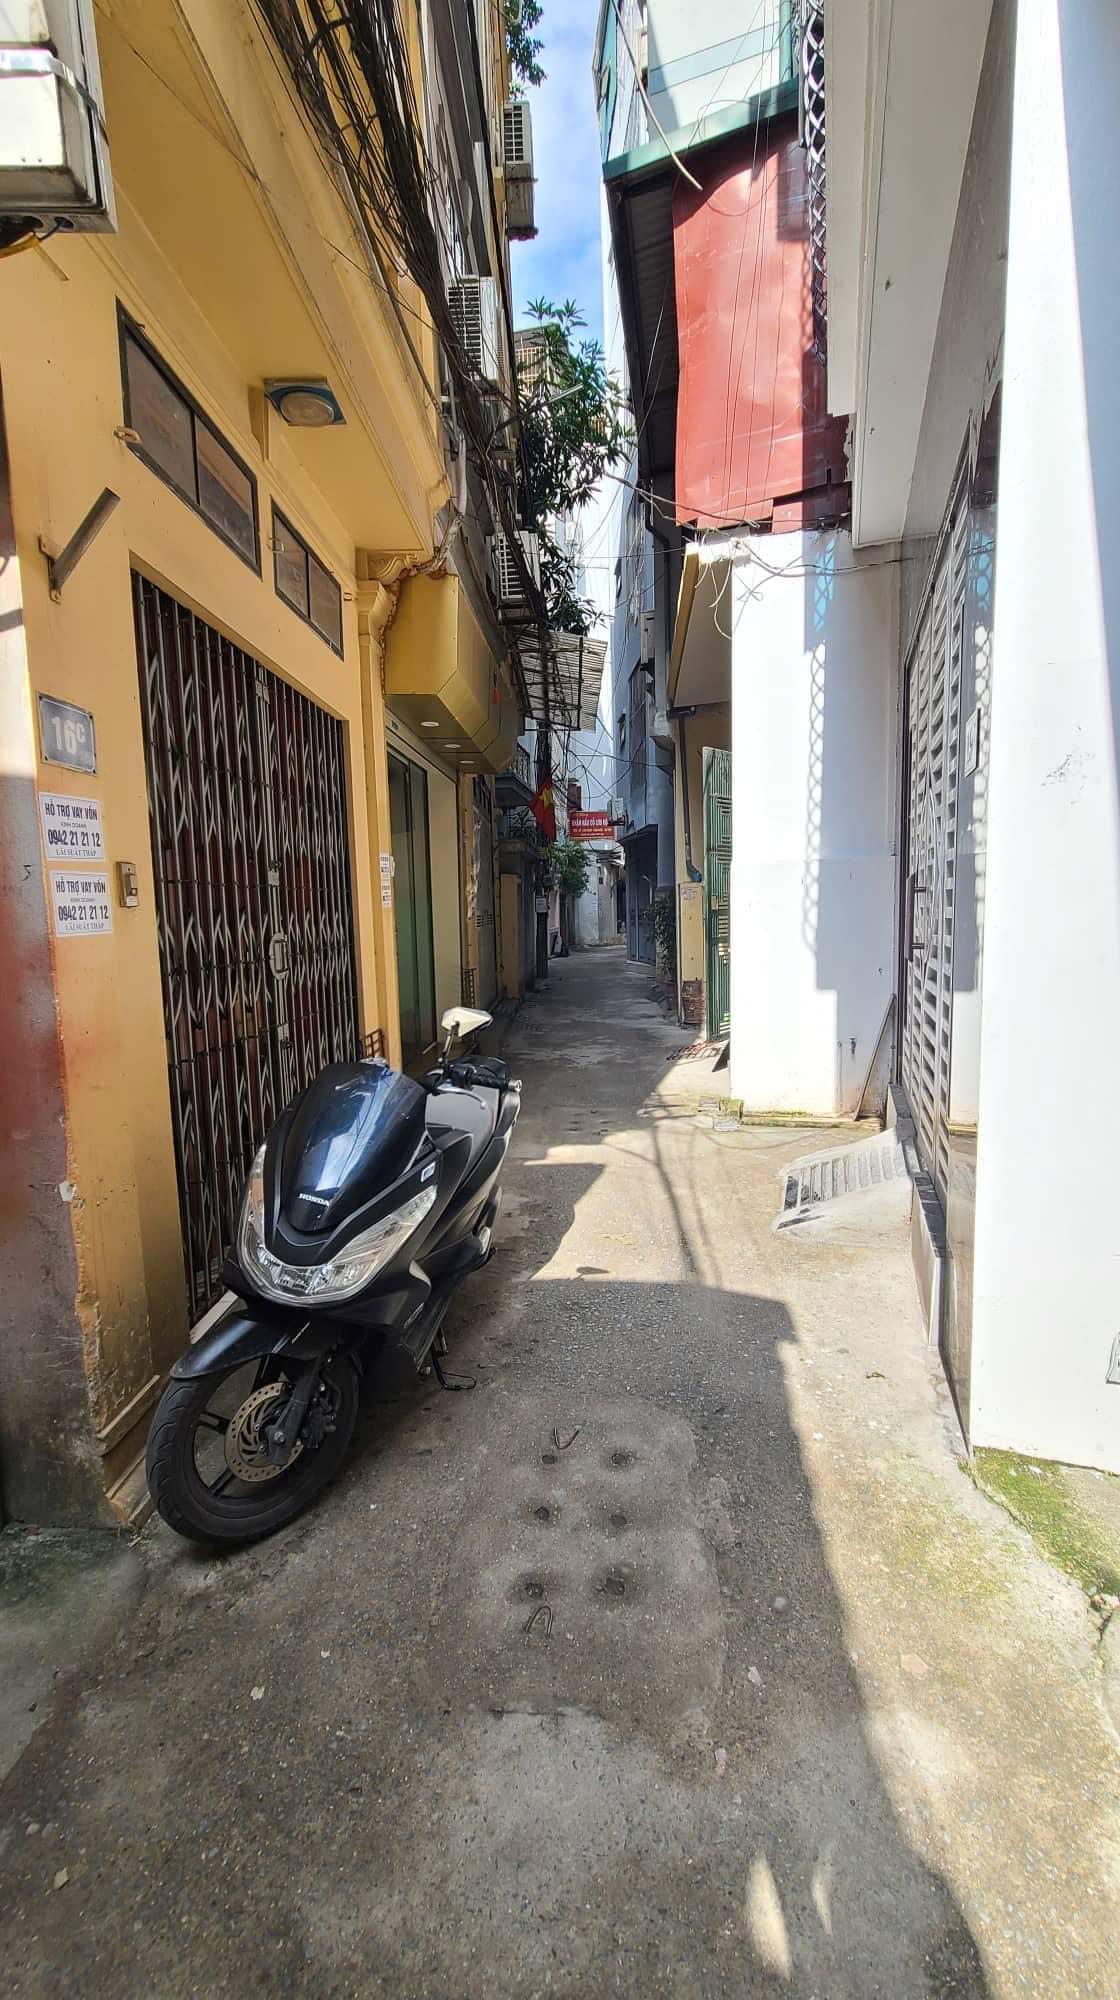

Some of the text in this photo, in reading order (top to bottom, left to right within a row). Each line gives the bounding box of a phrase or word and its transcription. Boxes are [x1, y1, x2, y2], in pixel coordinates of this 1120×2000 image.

[56, 804, 71, 820] TRỢ
[71, 806, 83, 819] VAY
[84, 805, 98, 821] VỐN
[47, 829, 101, 848] 0942 21 21 12
[66, 880, 80, 896] TRỢ
[80, 881, 92, 893] VAY
[93, 879, 106, 894] VỐN
[58, 904, 109, 921] 0942 21 21 12
[298, 1192, 331, 1209] HONDA
